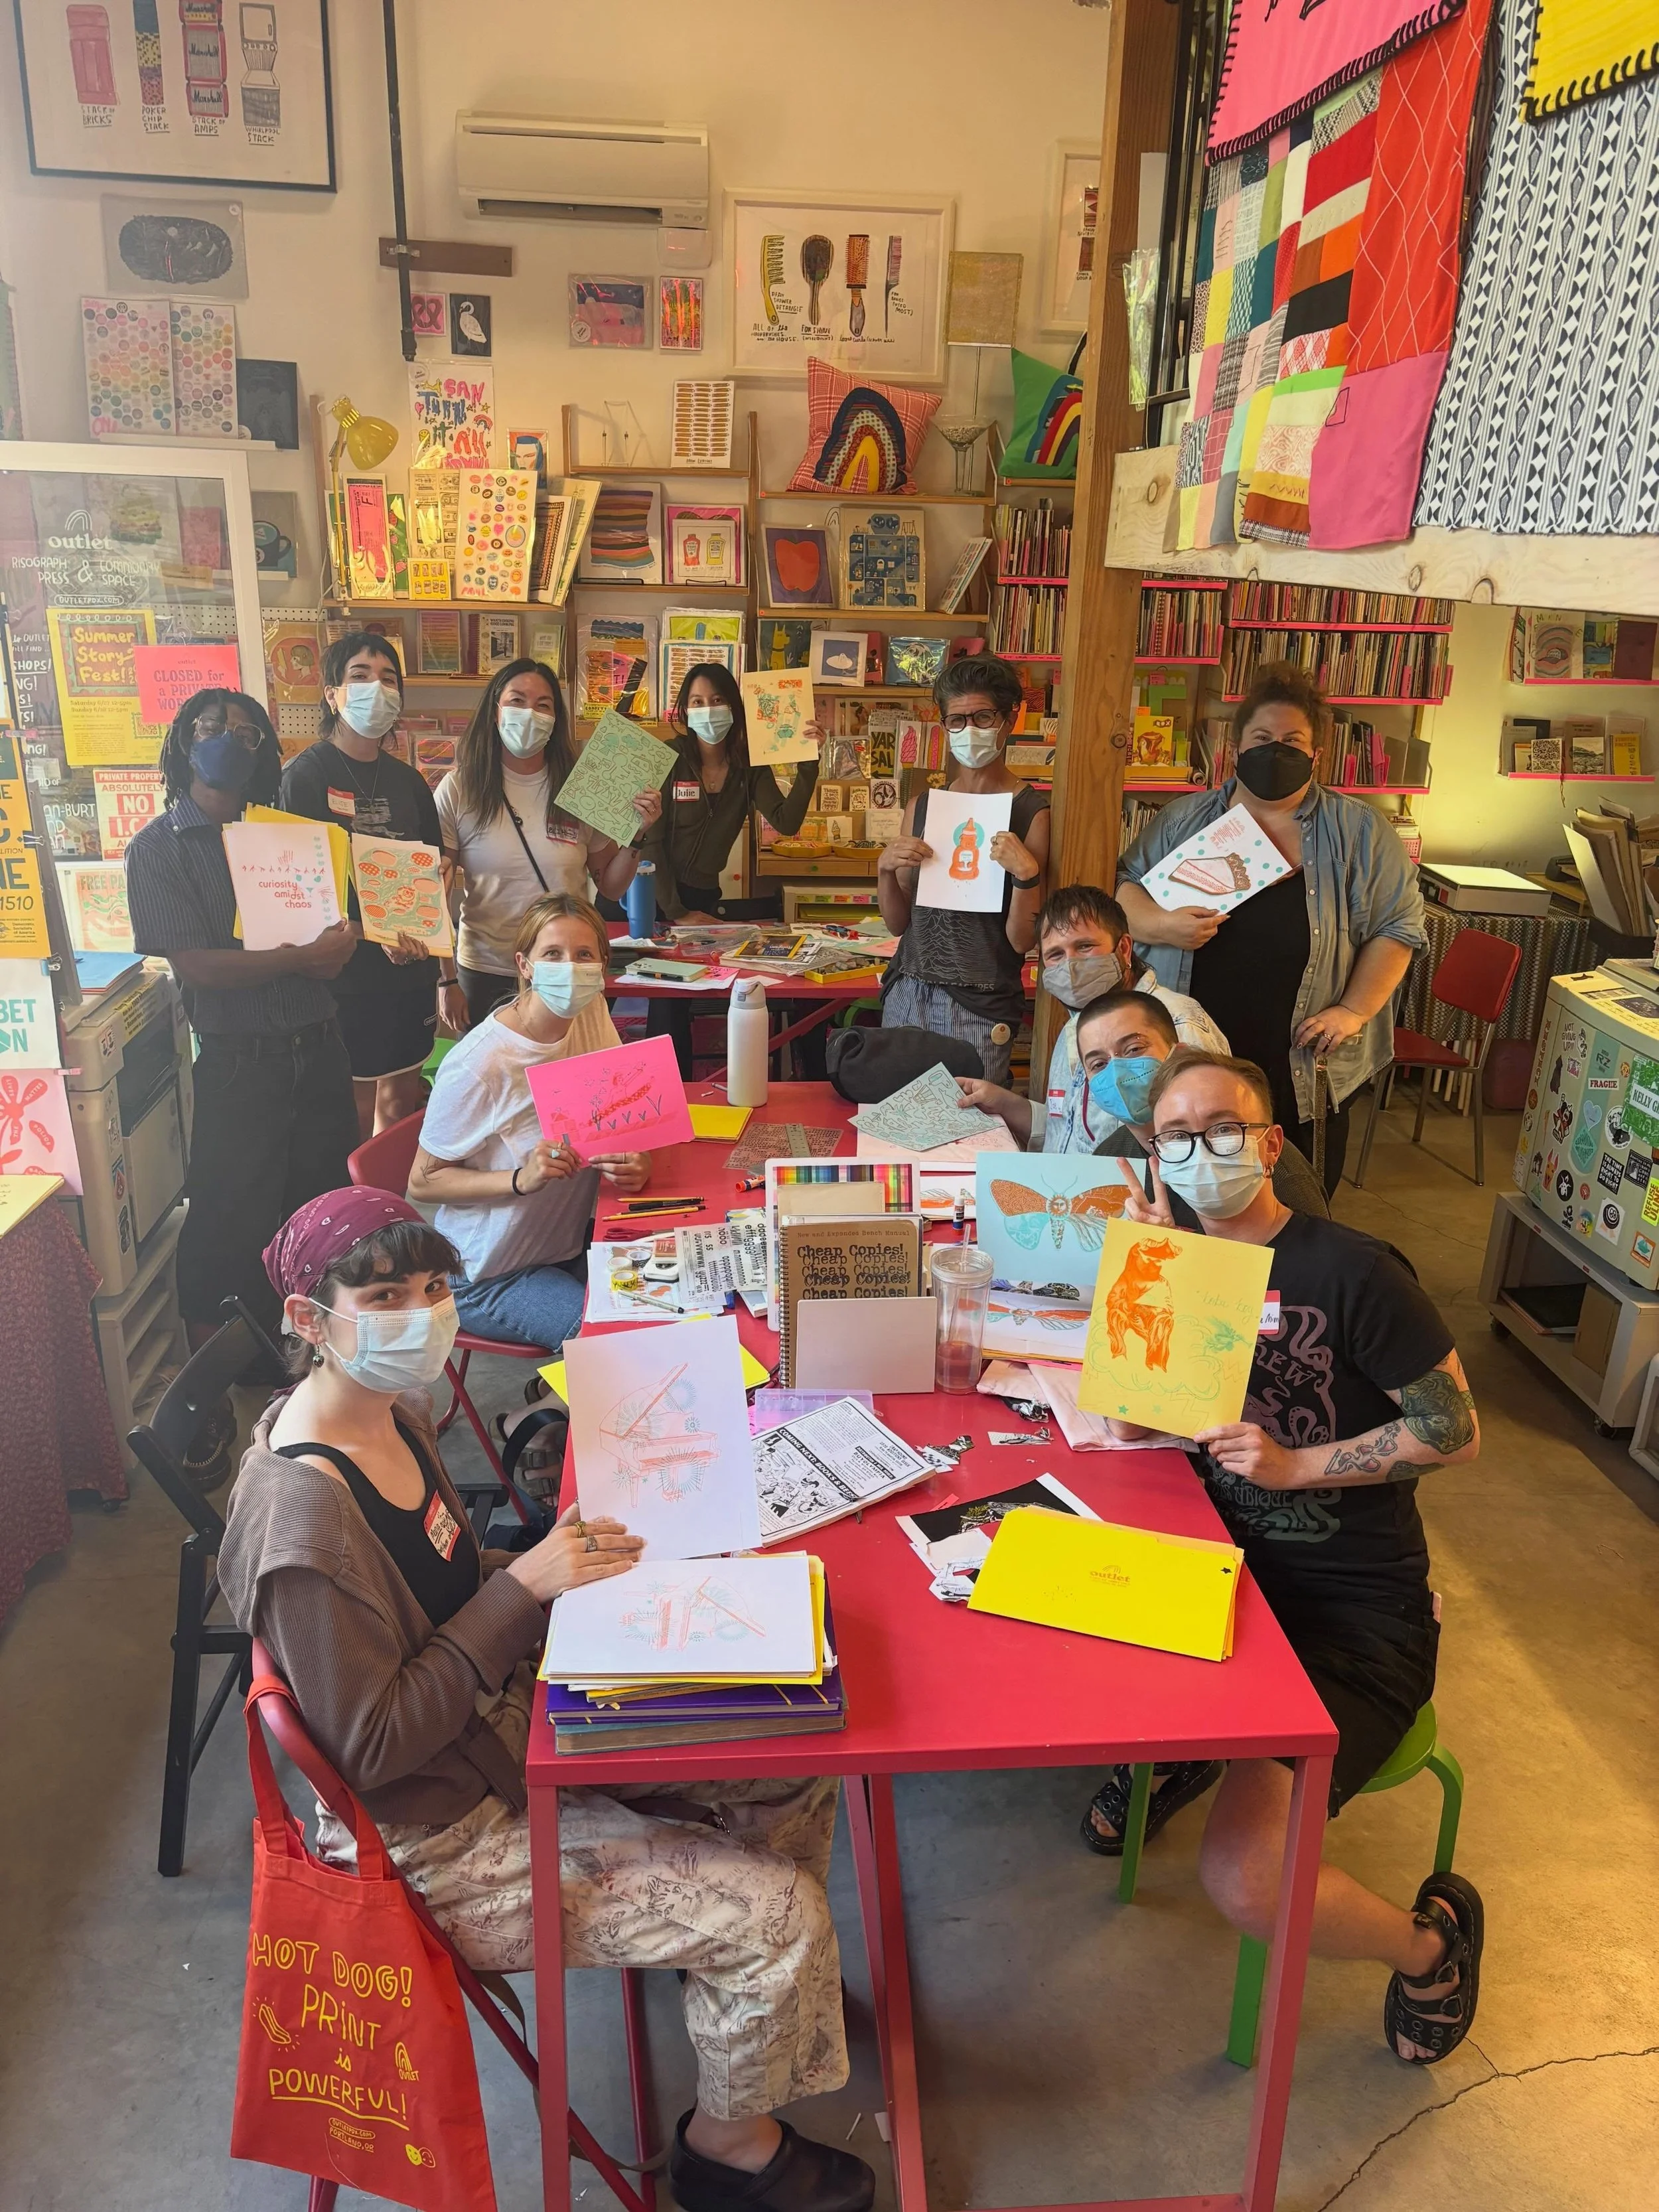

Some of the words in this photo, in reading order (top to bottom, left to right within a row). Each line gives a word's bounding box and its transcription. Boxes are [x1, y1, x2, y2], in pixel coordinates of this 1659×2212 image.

[141, 106, 166, 115] POKER
[82, 115, 112, 125] BRICKS
[194, 125, 219, 134] AMPS
[248, 133, 275, 143] STACK
[801, 325, 812, 334] FOR
[48, 533, 113, 550] outlet
[12, 557, 67, 569] RISOGRAPH
[77, 559, 93, 583] &
[38, 571, 70, 585] PRESS
[102, 573, 135, 586] SPACE
[58, 597, 119, 605] OUTLETPDX.COM
[74, 627, 135, 643] Summer
[76, 646, 131, 665] Story
[79, 666, 126, 684] Fest!
[153, 670, 203, 682] CLOSED
[207, 669, 224, 682] for
[159, 687, 165, 696] a
[99, 773, 128, 781] PRIVATE
[102, 784, 165, 792] ABSOLUTELY
[677, 788, 696, 798] Julie
[123, 794, 150, 814] NO
[80, 875, 107, 891] FREE
[258, 879, 299, 891] curiosity
[274, 889, 305, 900] amidst
[285, 900, 312, 909] chaos
[1565, 1022, 1574, 1031] NOT
[1561, 1028, 1577, 1042] GIVING
[1632, 1089, 1652, 1110] KELLY
[1605, 1154, 1613, 1163] THE
[1612, 1160, 1623, 1171] TIME
[1606, 1162, 1621, 1177] ALWAYS
[1601, 1166, 1614, 1179] RIGHT
[1605, 1177, 1619, 1190] RIGHT
[1643, 1183, 1656, 1216] REFUSE
[797, 1245, 843, 1258] Cheap
[849, 1243, 904, 1257] Copies!
[802, 1252, 847, 1267] Cheap
[854, 1252, 908, 1266] Copies!
[802, 1264, 847, 1278] Cheap
[853, 1263, 908, 1278] Copies!
[804, 1273, 850, 1288] Cheap
[856, 1271, 911, 1286] Copies!
[802, 1287, 847, 1300] Cheap
[854, 1286, 908, 1299] Copies!
[778, 1428, 802, 1449] COMING
[814, 1461, 835, 1482] BOOKS
[1089, 1570, 1131, 1584] outlet
[253, 1933, 321, 1974] HOT
[332, 1951, 413, 2008] DOG!
[334, 2048, 352, 2073] is
[399, 2069, 420, 2083] OUTLET
[269, 2068, 407, 2121] POWERFUL!
